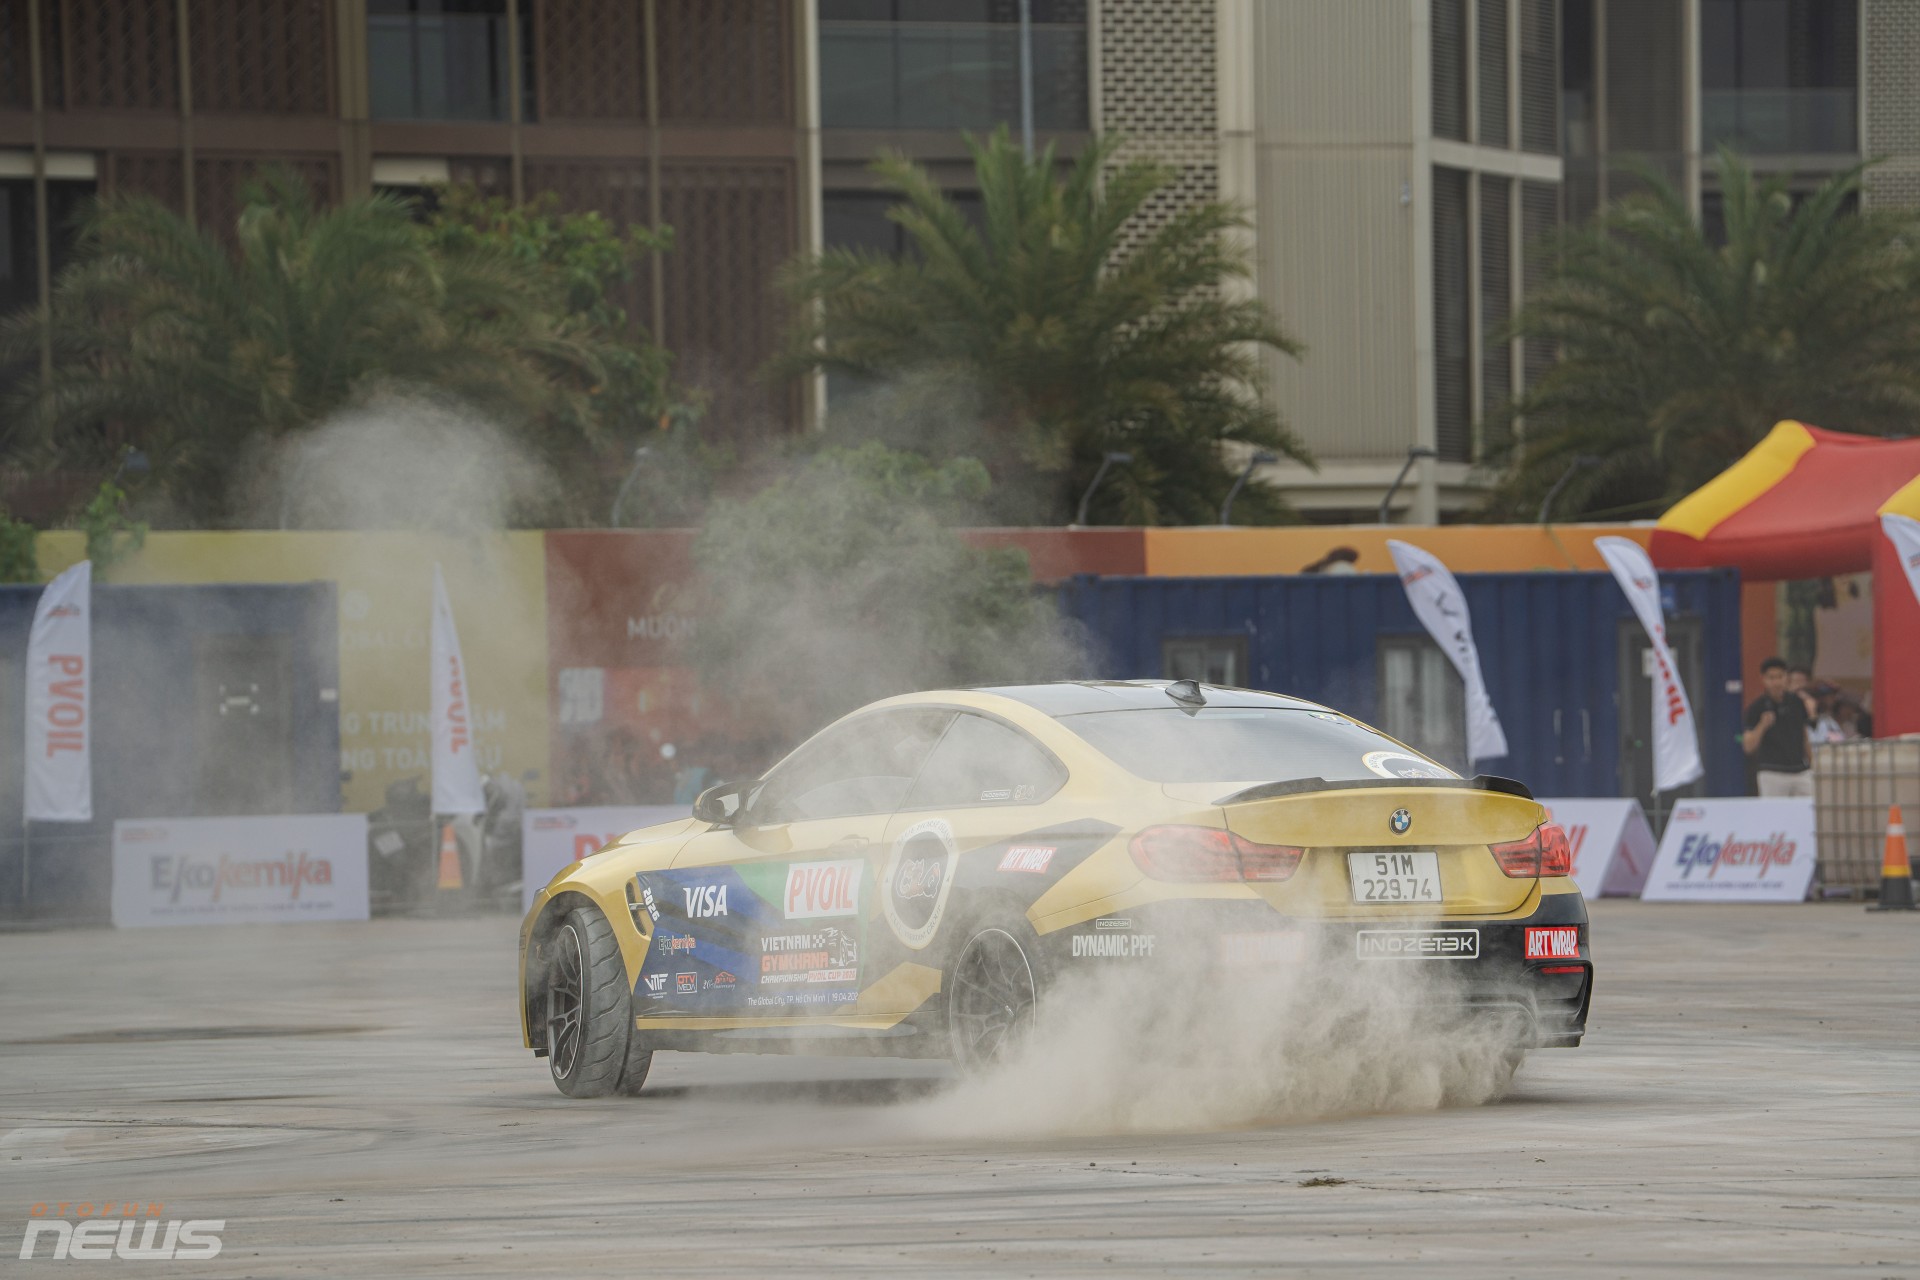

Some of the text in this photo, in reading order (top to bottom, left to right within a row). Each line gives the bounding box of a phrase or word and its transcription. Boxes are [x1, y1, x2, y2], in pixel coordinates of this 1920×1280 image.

[46, 655, 84, 759] PVOIL
[1021, 849, 1054, 871] WRAP
[1375, 854, 1414, 875] 51M
[1676, 832, 1797, 879] Ekokemika
[790, 866, 853, 913] PVOIL
[1363, 878, 1433, 900] 229.74
[643, 887, 661, 922] 2026
[683, 885, 728, 918] VISA
[761, 935, 810, 952] VIETNAM
[1072, 935, 1156, 957] DYNAMIC PPF
[1528, 930, 1577, 956] ART WRAP
[761, 952, 829, 972] GYMKHANA
[761, 973, 808, 984] CHAMPIONSHIP
[748, 997, 757, 1006] The
[758, 996, 773, 1005] Global
[813, 993, 826, 1003] Minh
